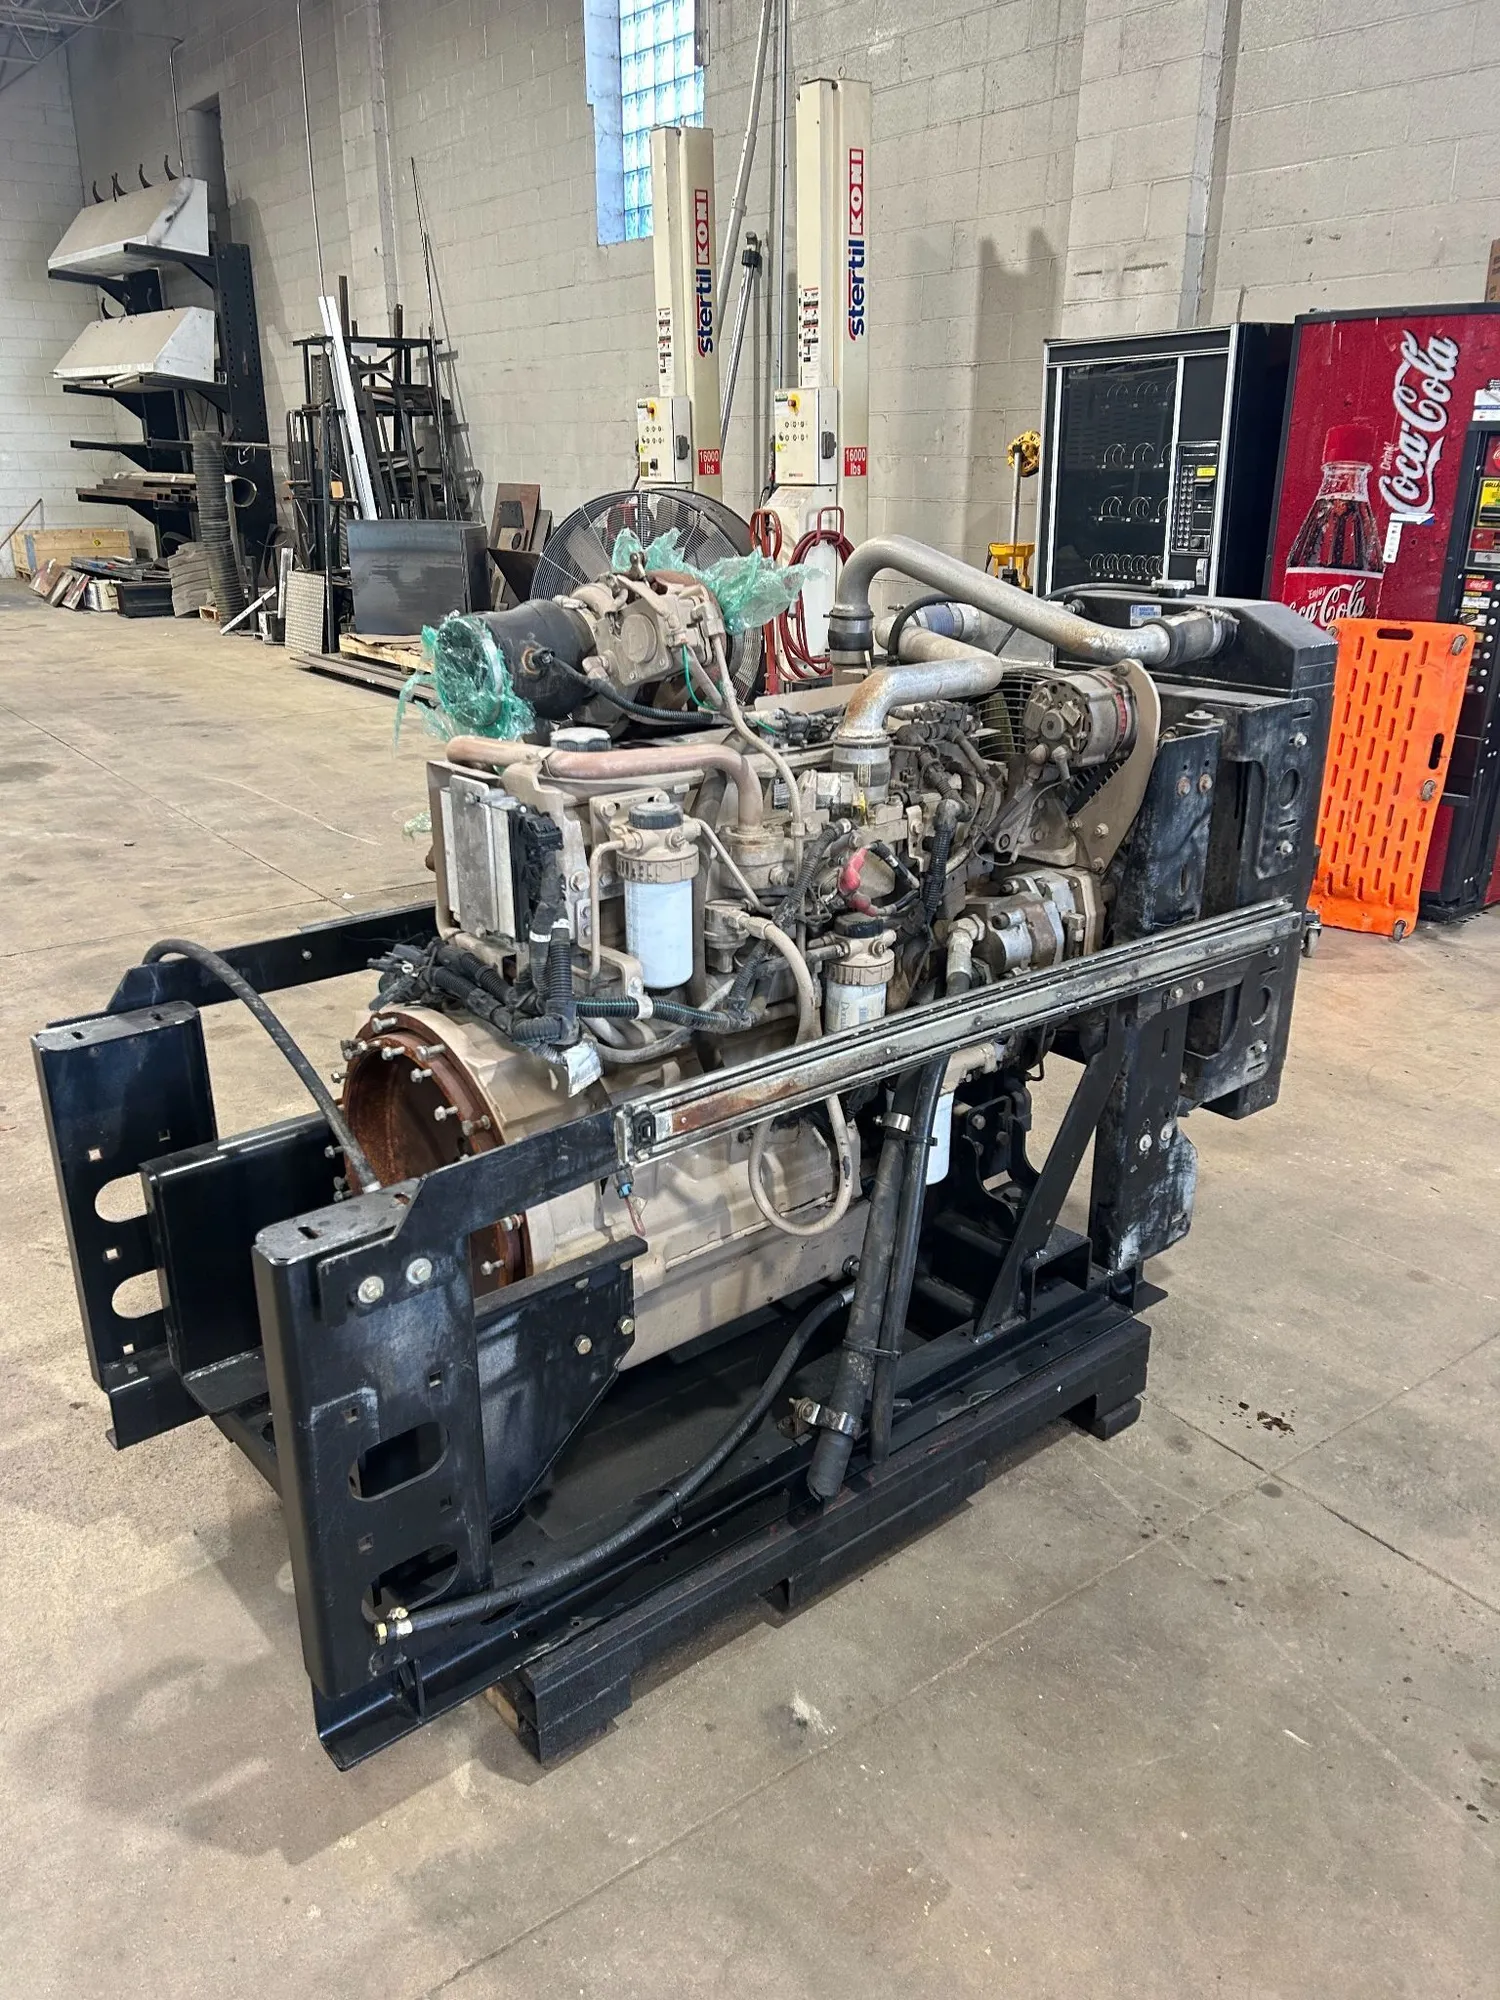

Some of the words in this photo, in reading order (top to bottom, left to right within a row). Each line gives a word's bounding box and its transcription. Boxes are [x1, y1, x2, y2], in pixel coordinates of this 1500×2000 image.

[850, 149, 863, 235] KONI
[696, 190, 709, 265] KONI
[696, 269, 712, 357] stertil
[848, 240, 864, 341] stertil
[1379, 329, 1459, 513] Coca-Cola
[699, 450, 719, 462] 16000
[704, 463, 715, 474] lbs
[845, 448, 866, 462] 16000
[850, 462, 861, 475] lbs
[1290, 579, 1366, 627] ca-Cola
[1307, 586, 1327, 599] Enjoy
